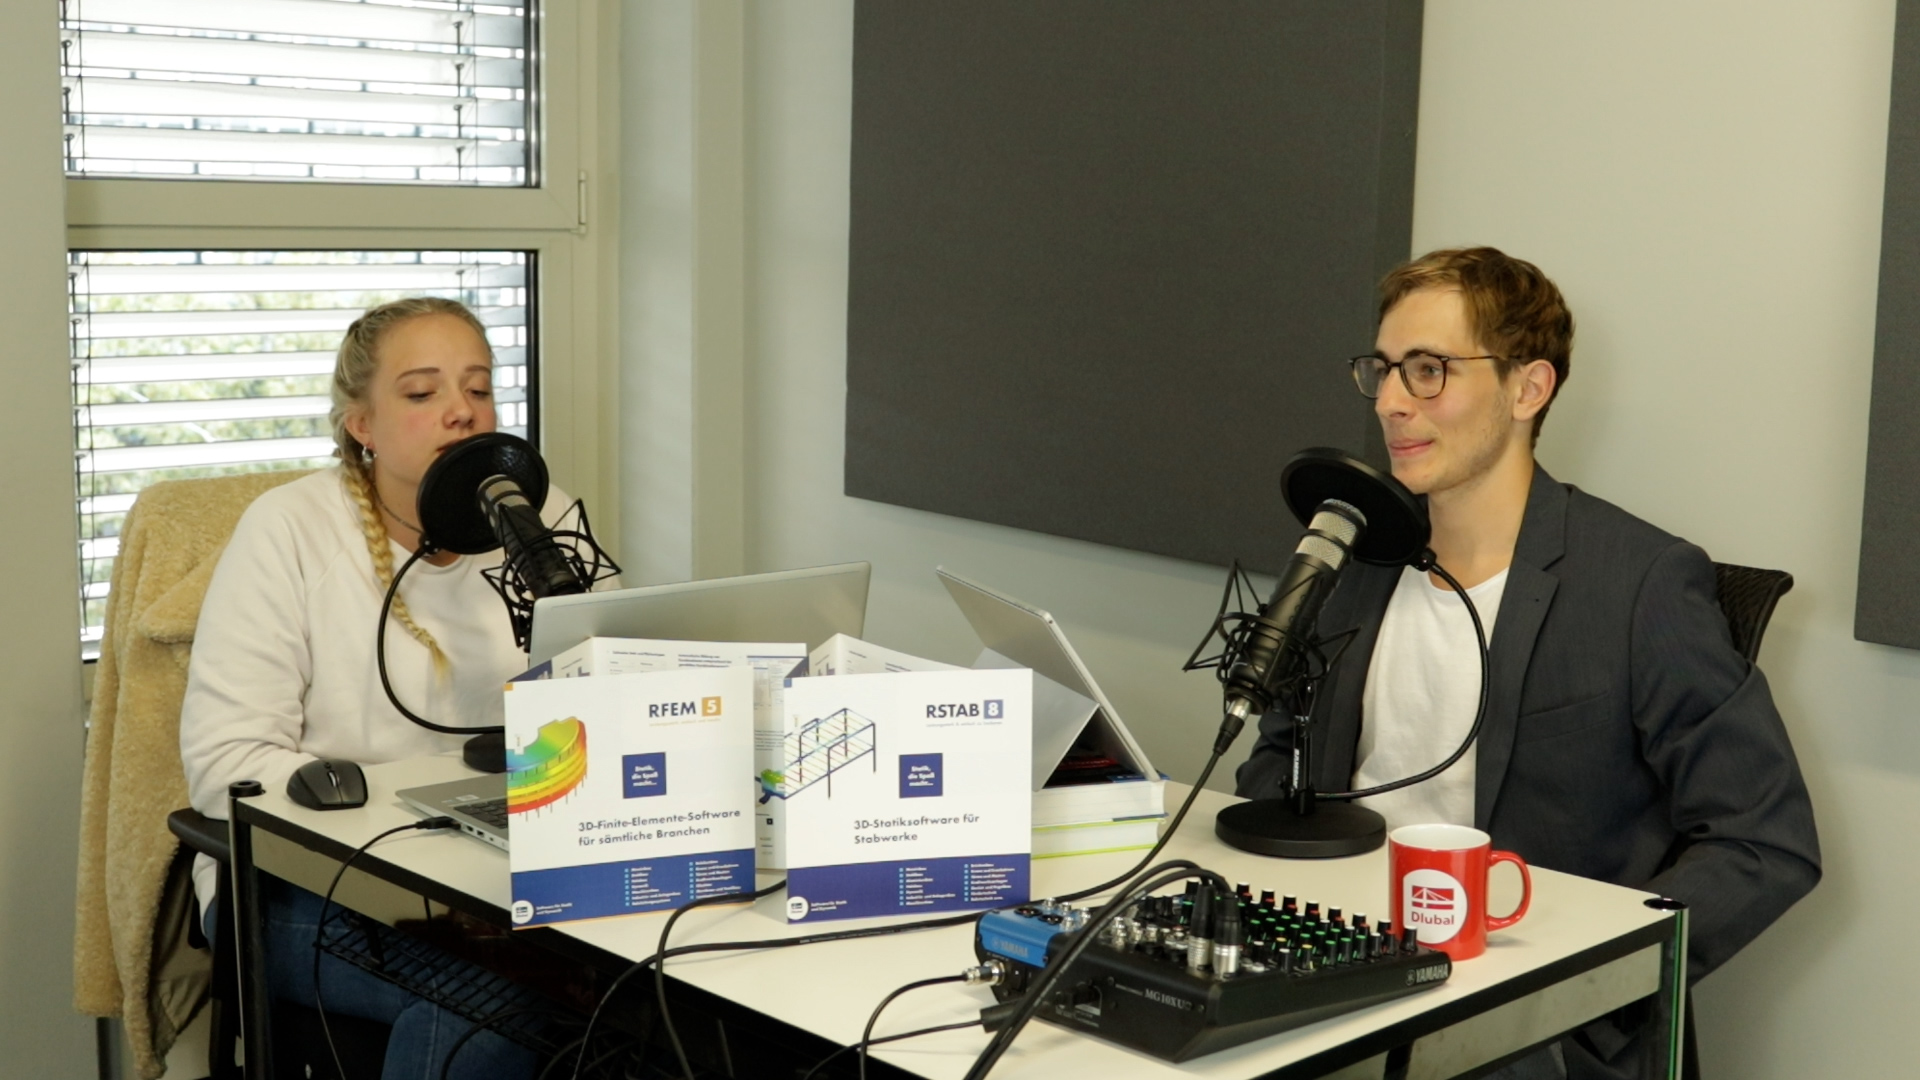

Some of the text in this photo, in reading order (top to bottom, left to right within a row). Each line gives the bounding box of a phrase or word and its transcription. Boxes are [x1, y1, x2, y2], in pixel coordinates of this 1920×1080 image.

[649, 700, 717, 718] RFEM 5
[926, 702, 999, 718] RSTAB 8
[578, 810, 741, 832] 3D-Finite-Elemente-Software
[853, 814, 980, 830] 3D-Statiksoftware für
[578, 826, 710, 846] für sämtliche Branchen
[854, 832, 918, 845] Stabwerke
[1411, 911, 1455, 925] Dlubal
[1416, 963, 1448, 983] YAMAHA
